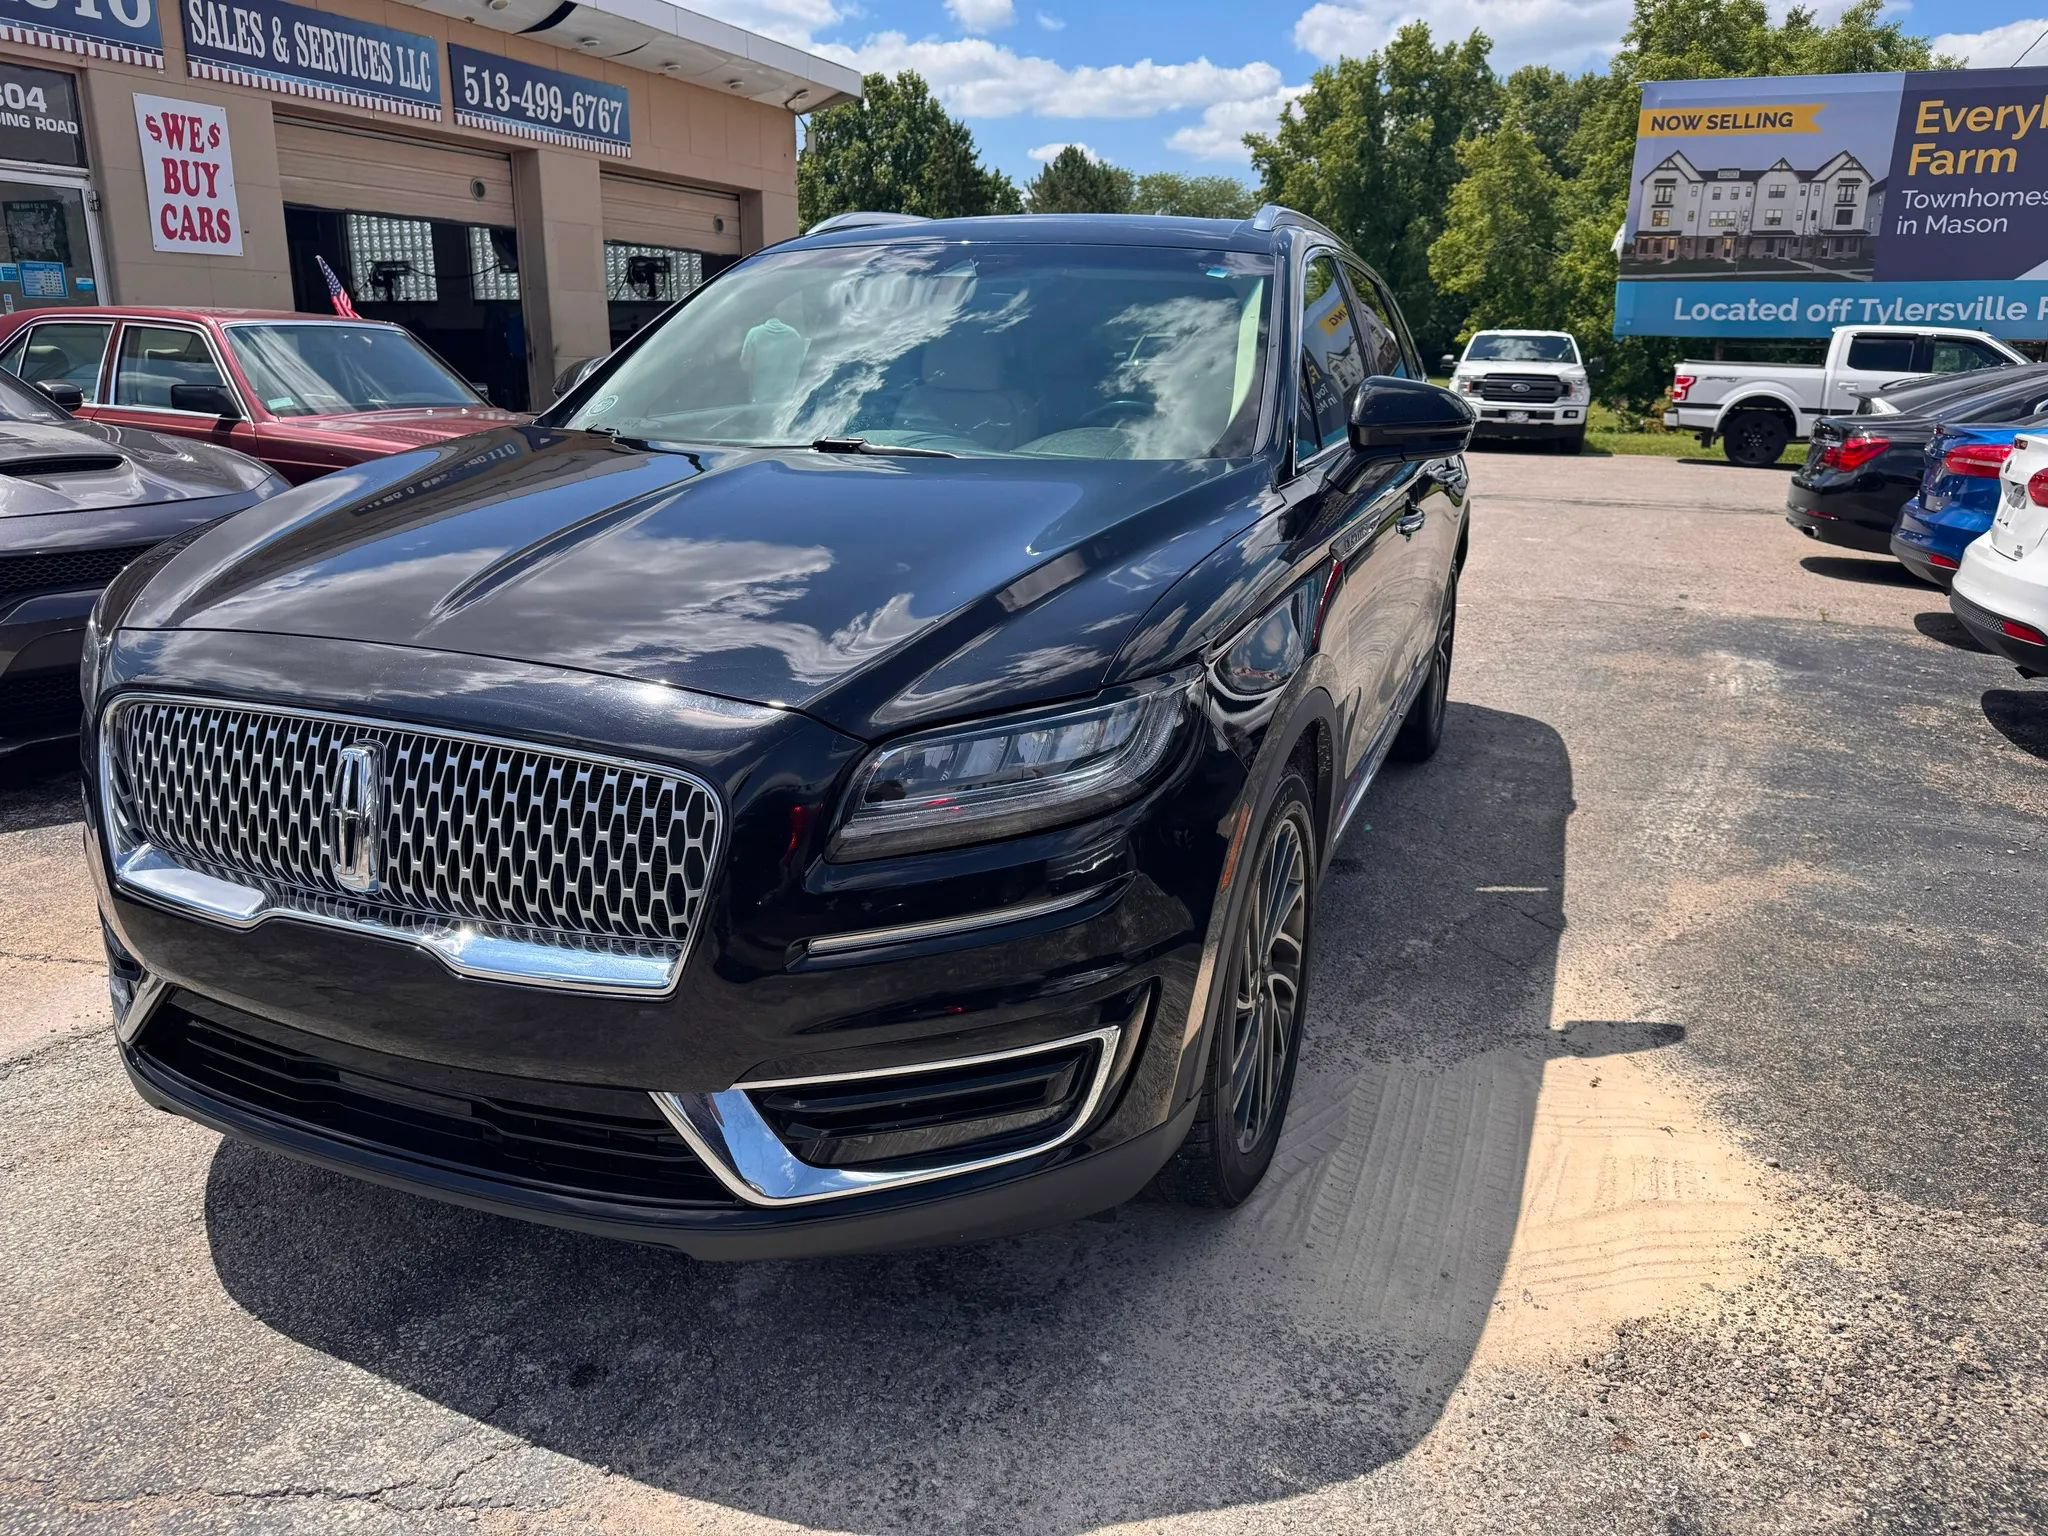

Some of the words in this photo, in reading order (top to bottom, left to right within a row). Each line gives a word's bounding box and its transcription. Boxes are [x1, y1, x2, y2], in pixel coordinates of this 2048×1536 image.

[189, 0, 265, 59] SALES
[272, 16, 290, 64] &
[294, 21, 394, 85] SERVICES
[396, 46, 432, 93] LLC
[0, 82, 47, 113] 04
[463, 64, 623, 135] 513-499-6767
[0, 111, 31, 129] ING
[35, 116, 78, 134] ROAD
[1651, 115, 1703, 131] NOW
[1706, 112, 1793, 130] SELLING
[1908, 143, 2017, 176] Farm
[161, 157, 220, 198] BUY
[160, 203, 231, 244] CARS
[1896, 215, 1917, 234] in
[1925, 215, 2008, 234] Mason
[1674, 297, 1799, 322] Located
[1806, 298, 1853, 322] off
[1859, 296, 2027, 325] Tylersville
